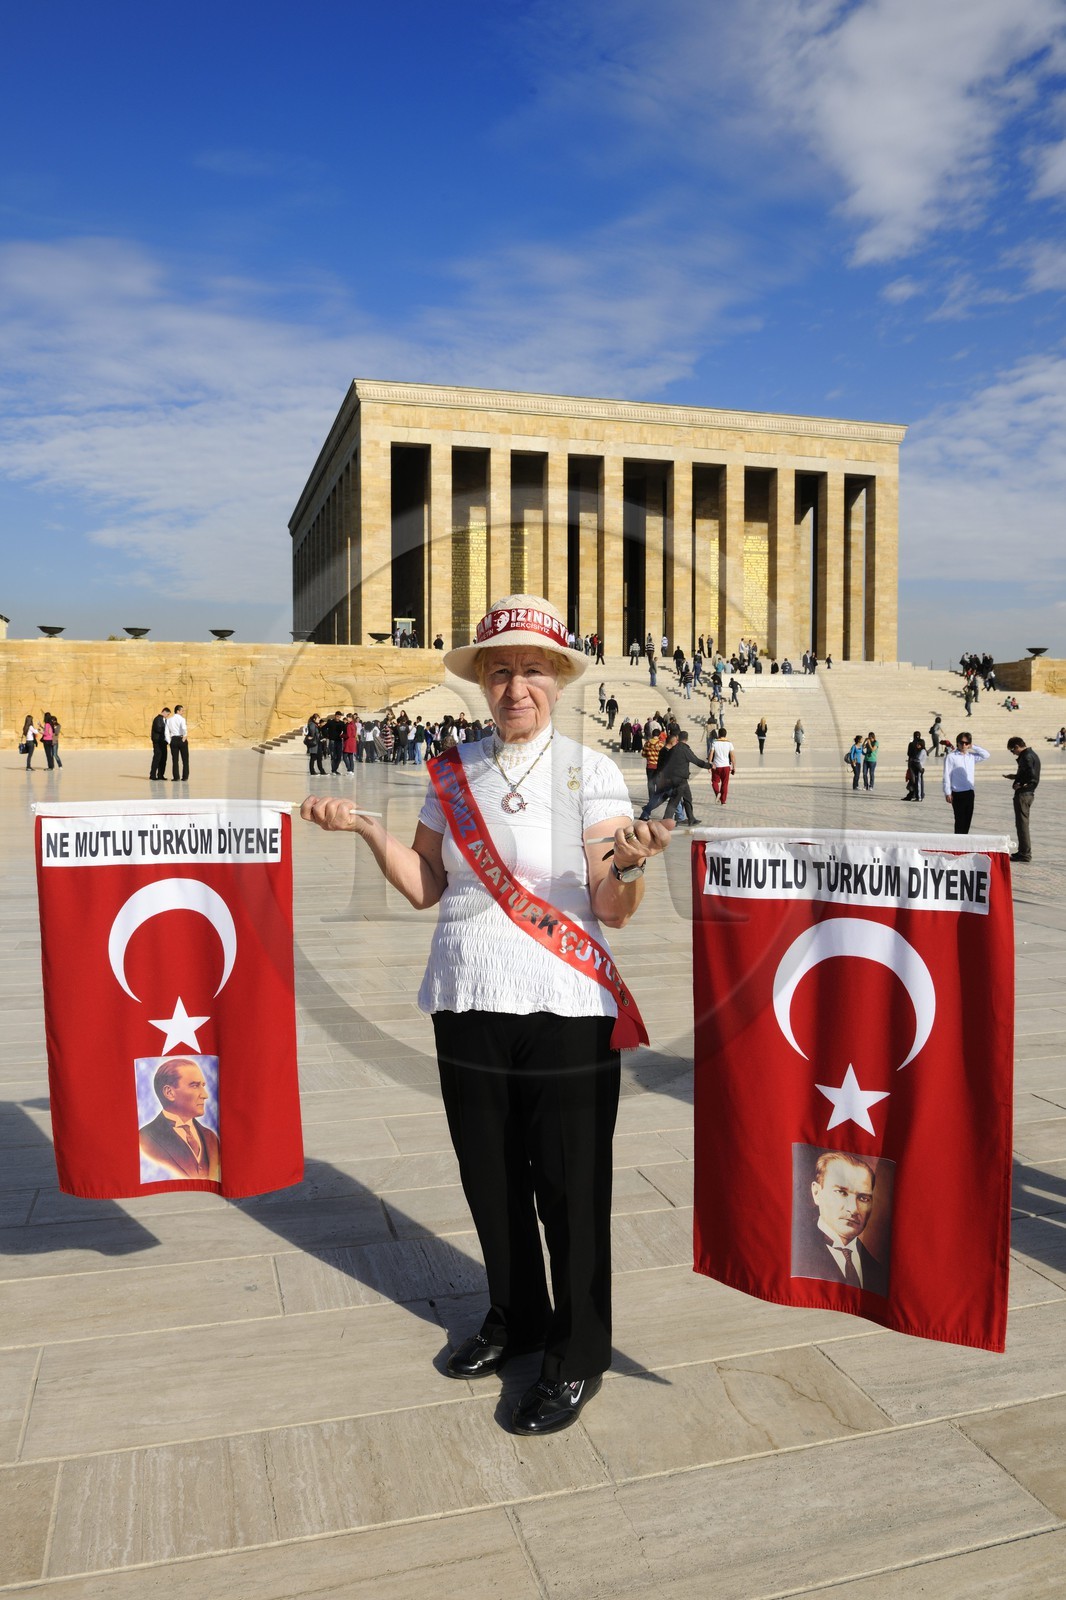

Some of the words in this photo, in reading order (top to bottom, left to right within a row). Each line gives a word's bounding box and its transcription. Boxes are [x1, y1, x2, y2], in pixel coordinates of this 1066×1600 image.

[510, 621, 550, 635] BEKÇİSİYİZ
[511, 609, 569, 643] İZİNDEYİ
[433, 759, 477, 839] HEPİMİZ
[46, 832, 69, 858] NE
[75, 830, 133, 858] MUTLU
[138, 824, 213, 856] TÜRKÜM
[218, 822, 279, 854] DİYENE
[708, 856, 731, 887] NE
[737, 858, 807, 889] MUTLU
[813, 855, 900, 898] TÜRKÜM
[908, 859, 987, 904] DİYENE
